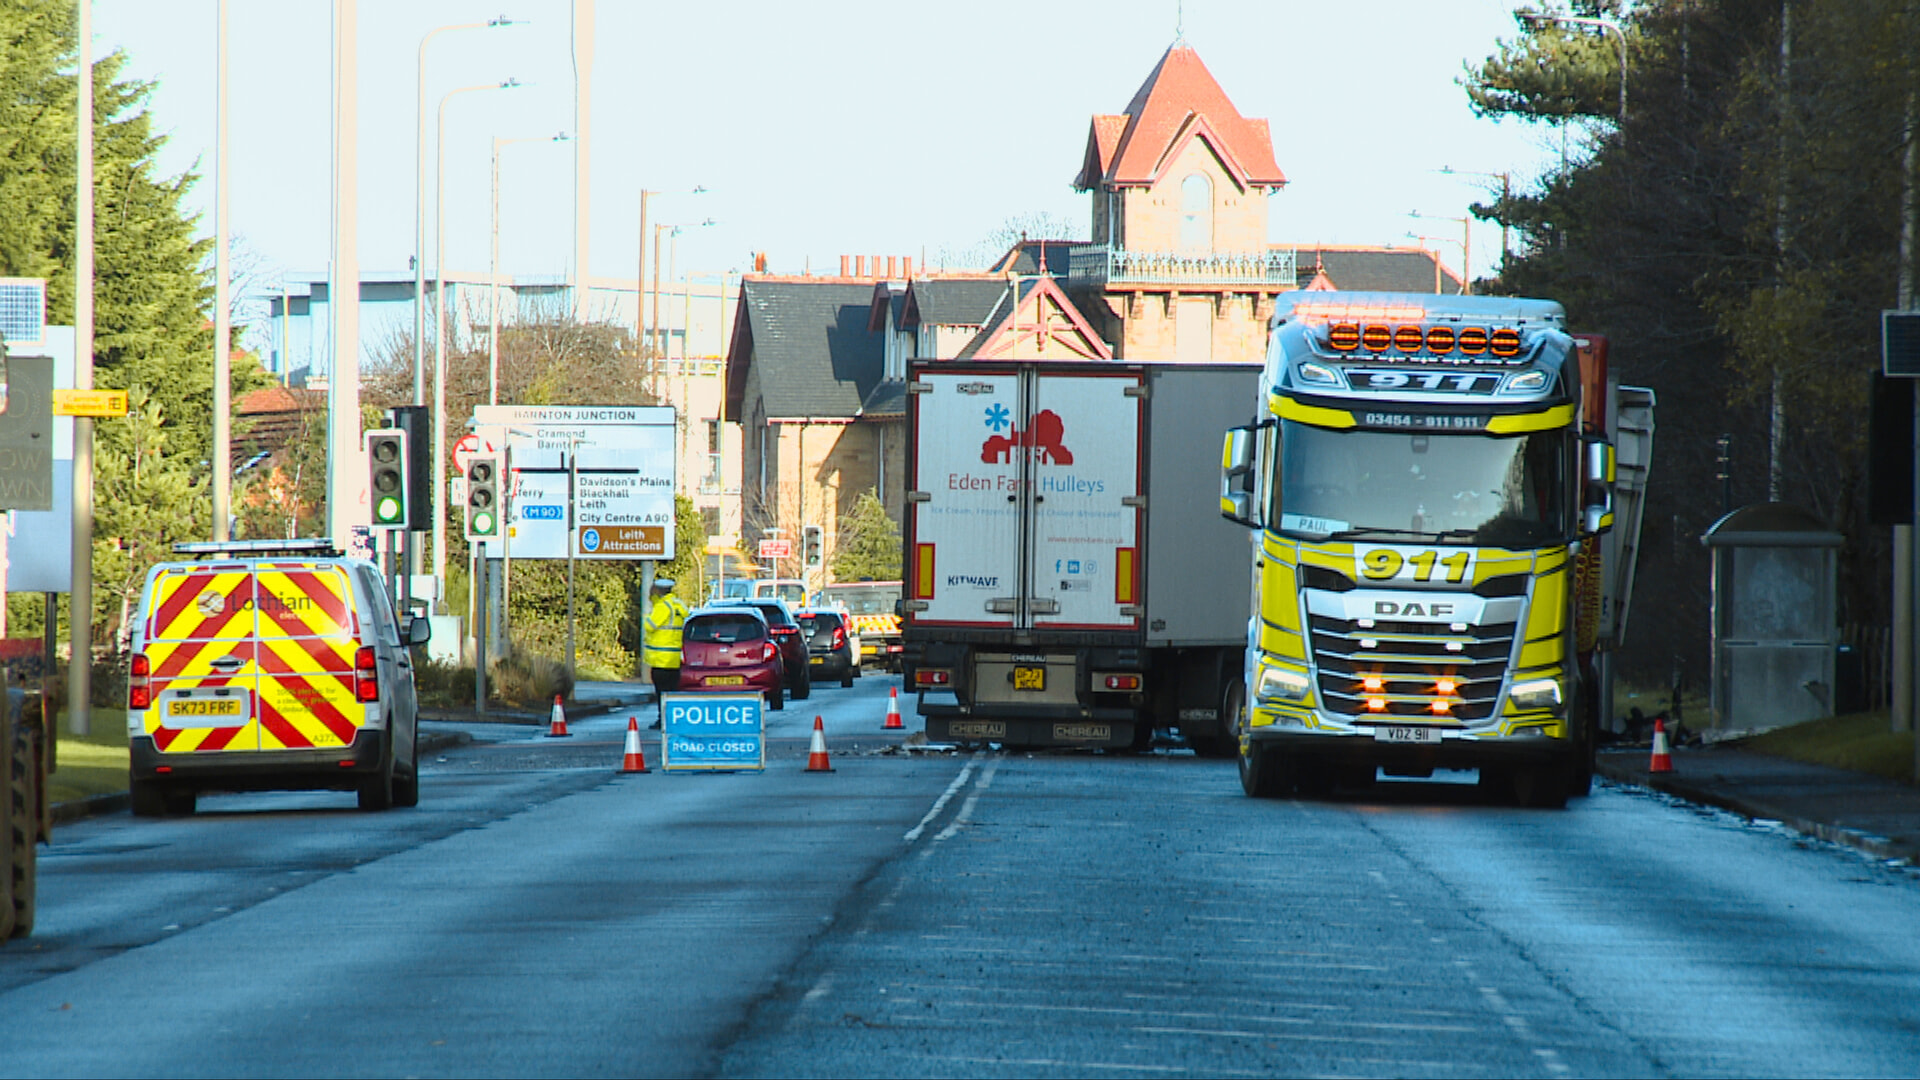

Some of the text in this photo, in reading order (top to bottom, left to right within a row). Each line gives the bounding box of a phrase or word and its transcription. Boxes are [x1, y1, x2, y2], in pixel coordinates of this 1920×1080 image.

[1369, 373, 1478, 389] 911
[576, 411, 636, 421] JUNCTION
[1366, 413, 1411, 425] 03454
[1425, 416, 1449, 427] 911
[1454, 416, 1477, 427] 911
[537, 429, 585, 438] Cramond
[579, 477, 671, 487] Davidson's Mains
[949, 474, 991, 491] Eden
[1043, 475, 1105, 496] Hulleys
[579, 489, 629, 498] Blackhall
[579, 500, 607, 509] Leith
[579, 513, 601, 524] City
[604, 513, 641, 523] Centre
[1299, 518, 1329, 531] PAUL
[619, 529, 645, 540] Leith
[603, 540, 661, 551] Attractions
[1361, 548, 1471, 583] 911
[948, 575, 999, 587] KITWAVE
[231, 591, 311, 612] Lothian
[1375, 601, 1453, 616] DAF
[172, 701, 235, 714] SK73 FRF
[672, 706, 754, 725] POLICE
[951, 723, 1004, 734] CHEREAU
[1055, 726, 1108, 737] CHEREAU
[1415, 728, 1429, 740] 911
[672, 742, 755, 753] ROAD CLOSED
